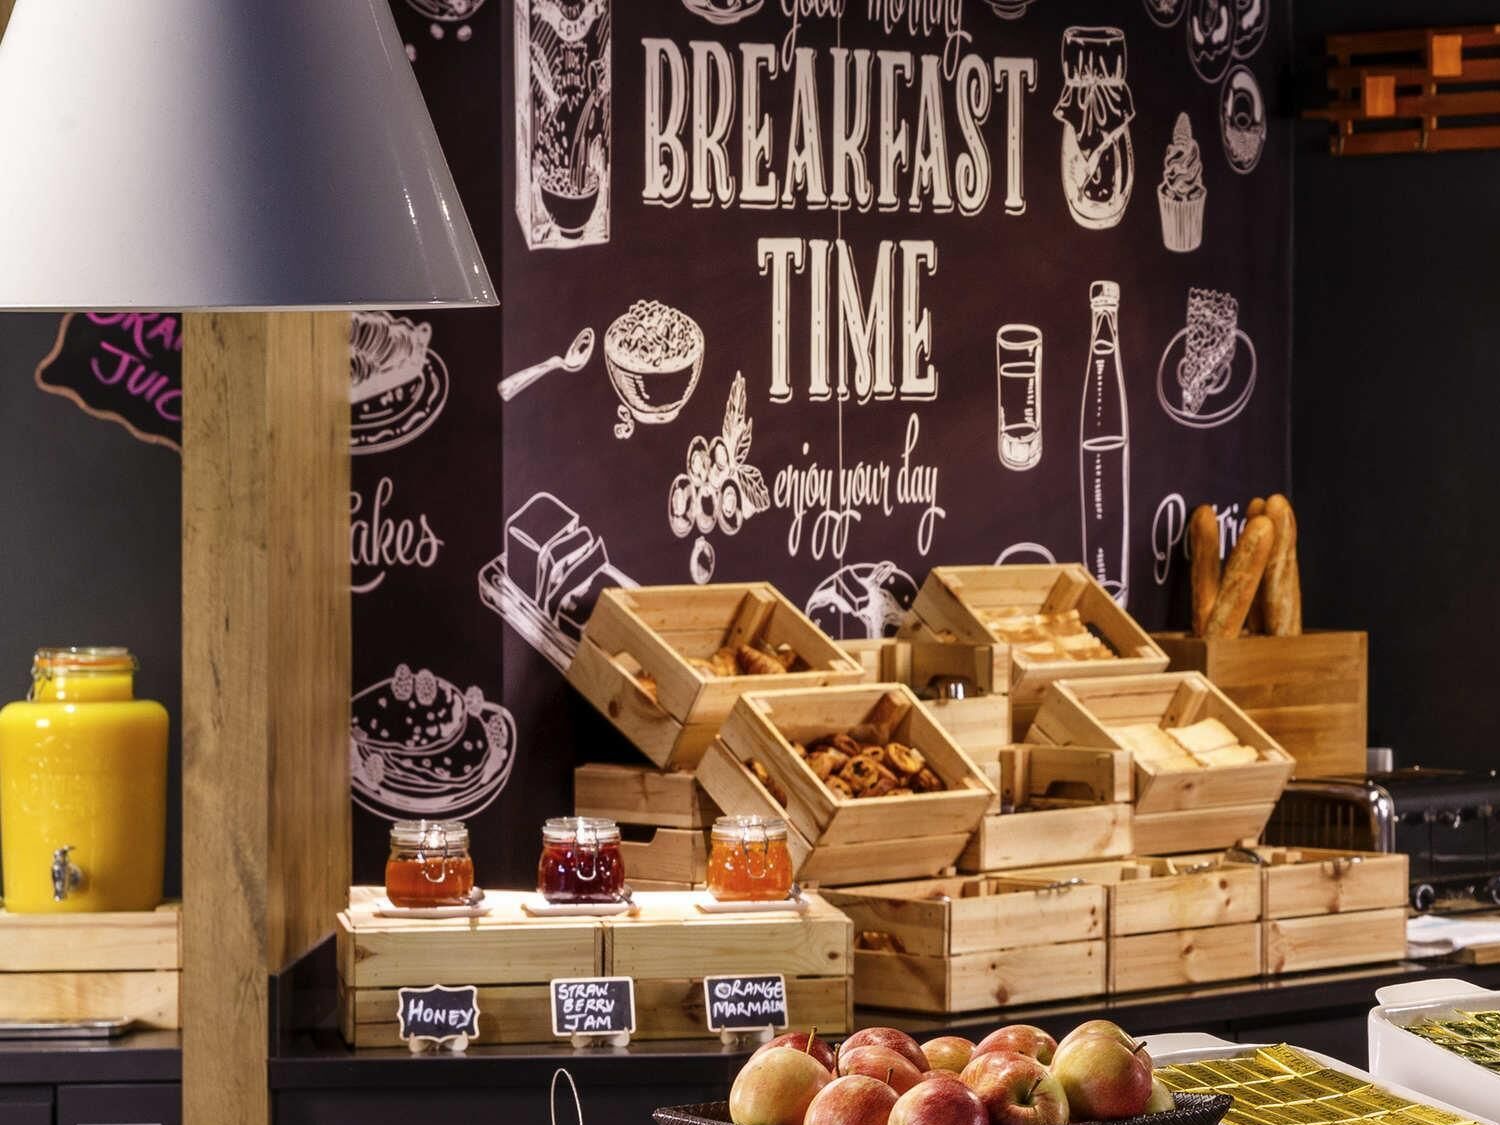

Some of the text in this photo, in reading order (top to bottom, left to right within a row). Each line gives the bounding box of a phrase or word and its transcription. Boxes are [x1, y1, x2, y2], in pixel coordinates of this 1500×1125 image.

[641, 37, 1038, 217] BREAKFAST
[757, 237, 938, 405] TIME
[773, 412, 947, 560] enjoy your day
[558, 983, 610, 1000] STRAW
[714, 979, 784, 1000] ORANGE
[407, 998, 474, 1029] HONEY
[563, 998, 615, 1014] BERRY
[564, 1013, 612, 1030] JAM
